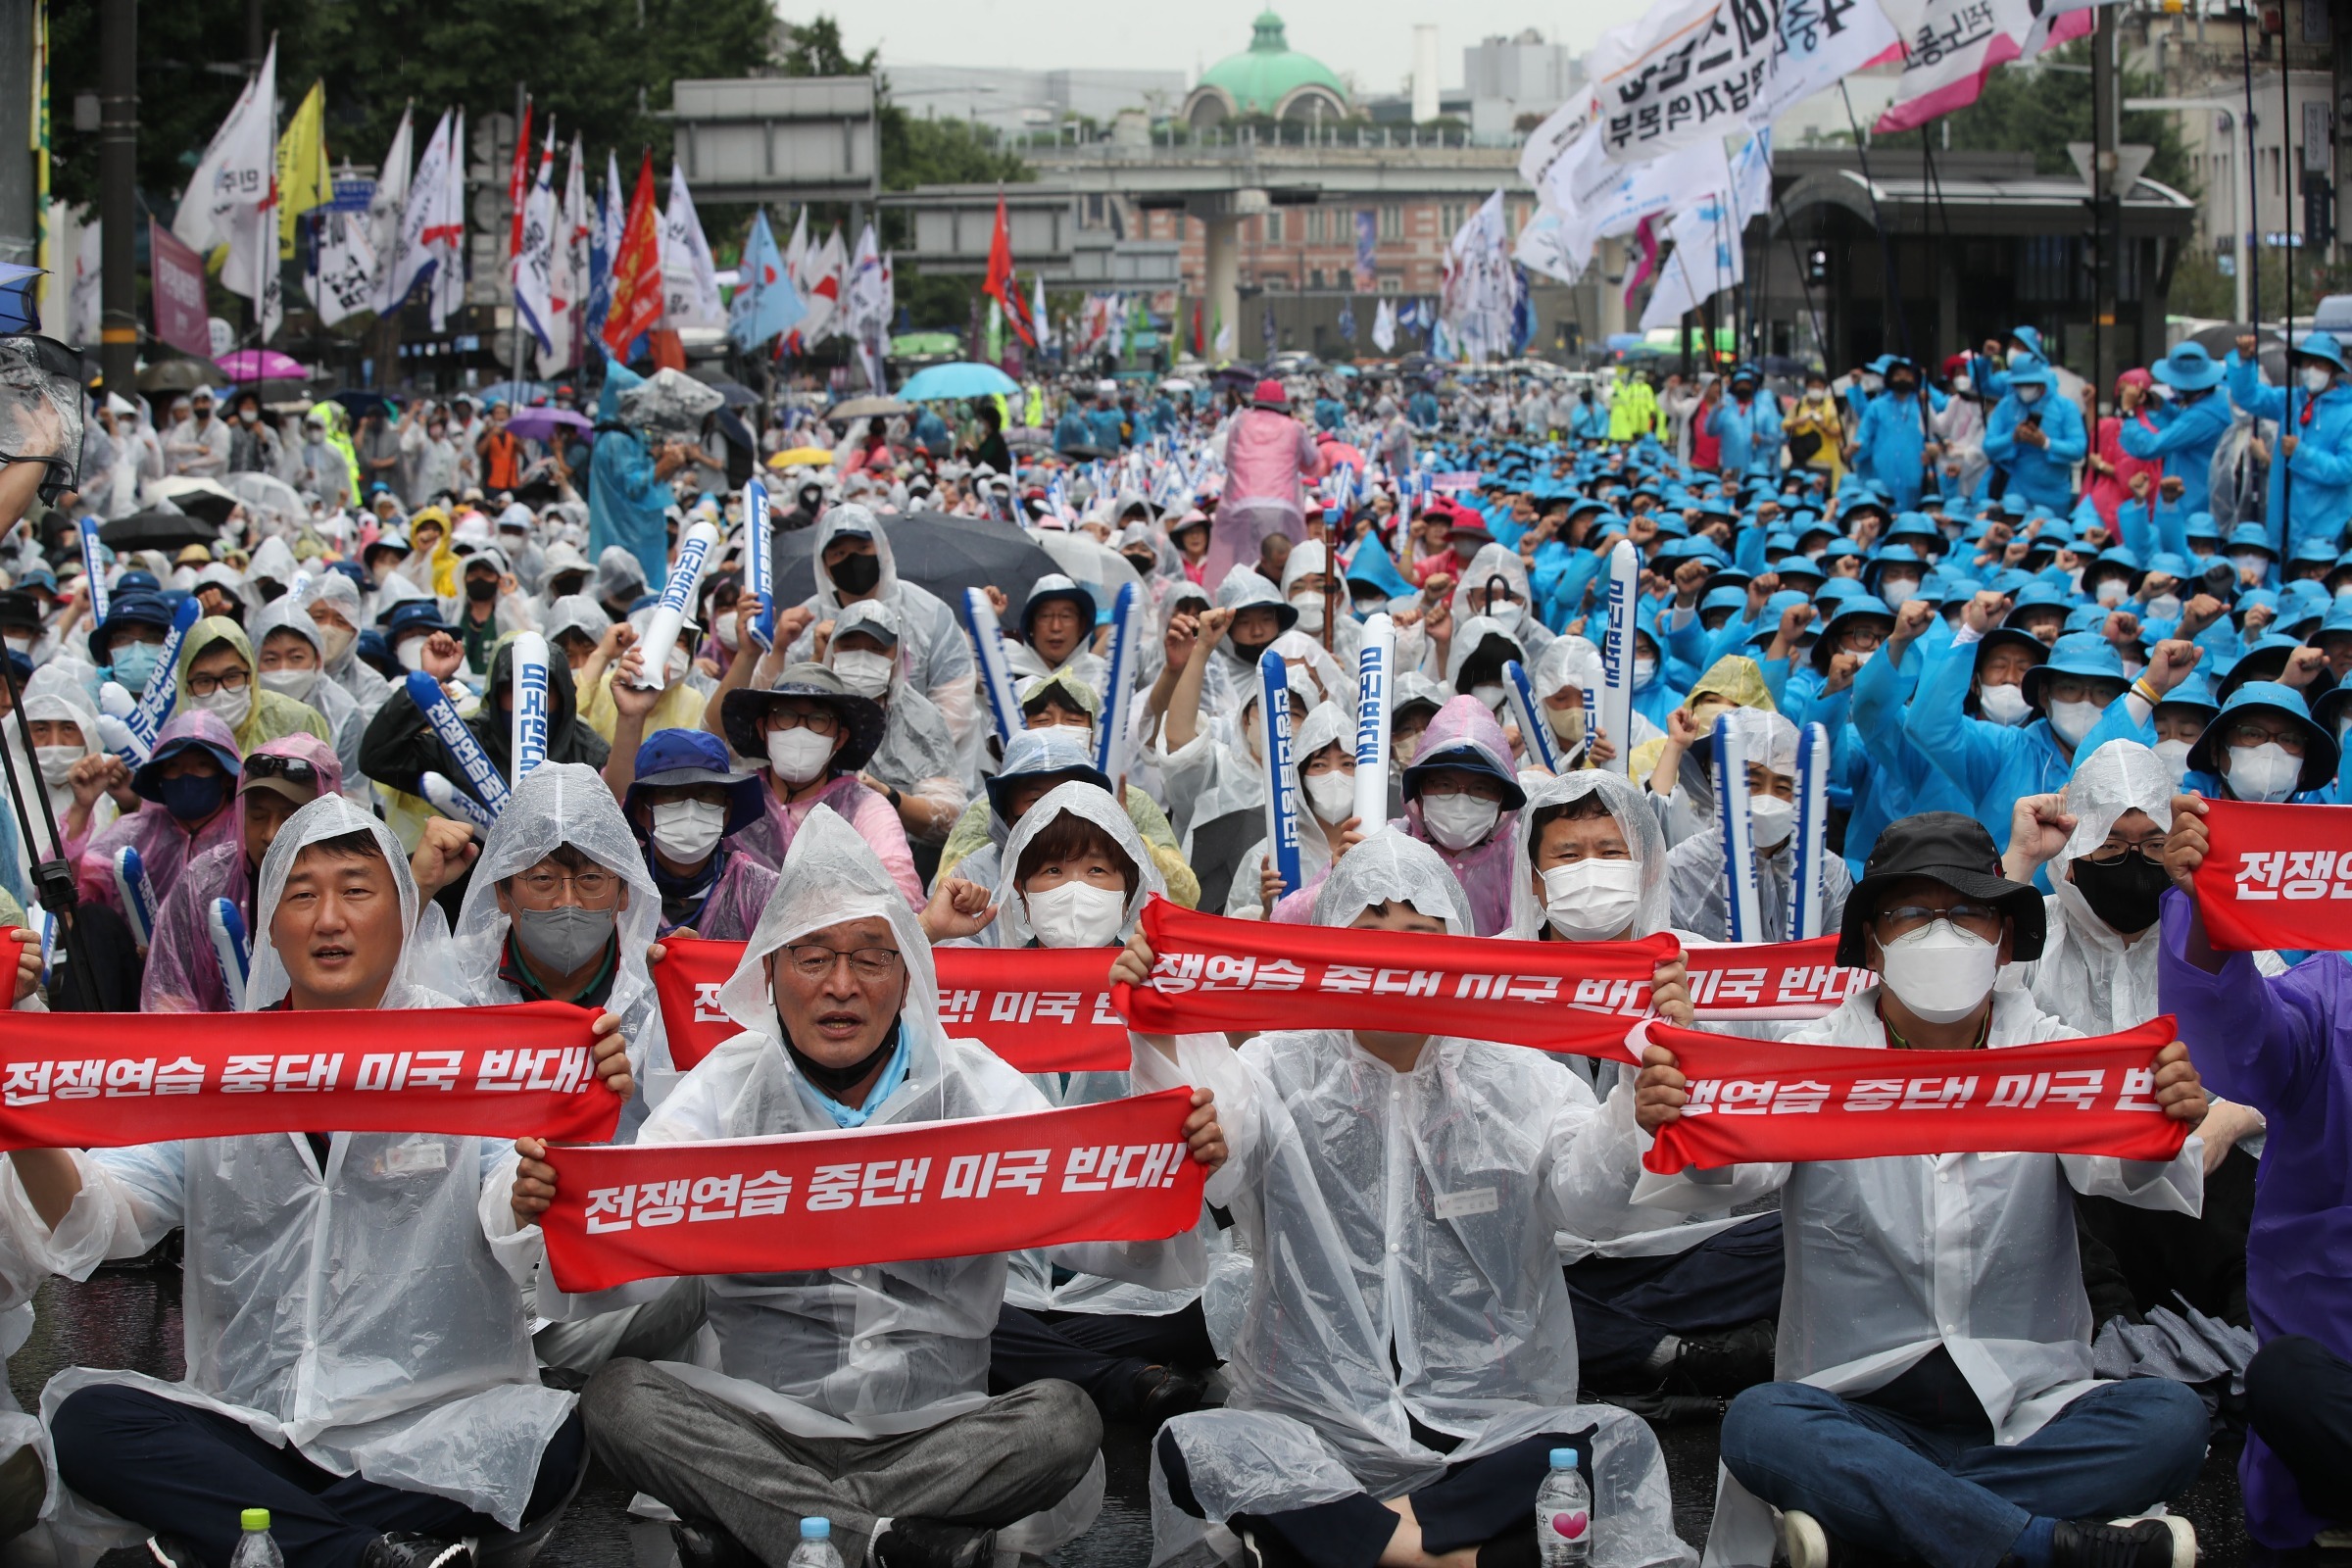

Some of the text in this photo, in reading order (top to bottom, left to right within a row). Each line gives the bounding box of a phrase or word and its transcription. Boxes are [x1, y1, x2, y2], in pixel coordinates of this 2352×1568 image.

[659, 538, 709, 613] 미국반대!
[1354, 646, 1383, 765] 미국반대!
[989, 992, 1082, 1025] 미국
[3, 1047, 595, 1106] 전쟁연습 중단! 미국 반대!
[1842, 1076, 1980, 1112] 중단!
[1988, 1068, 2106, 1110] 미국
[585, 1142, 1187, 1235] 전쟁연습 중단! 미국 반대!
